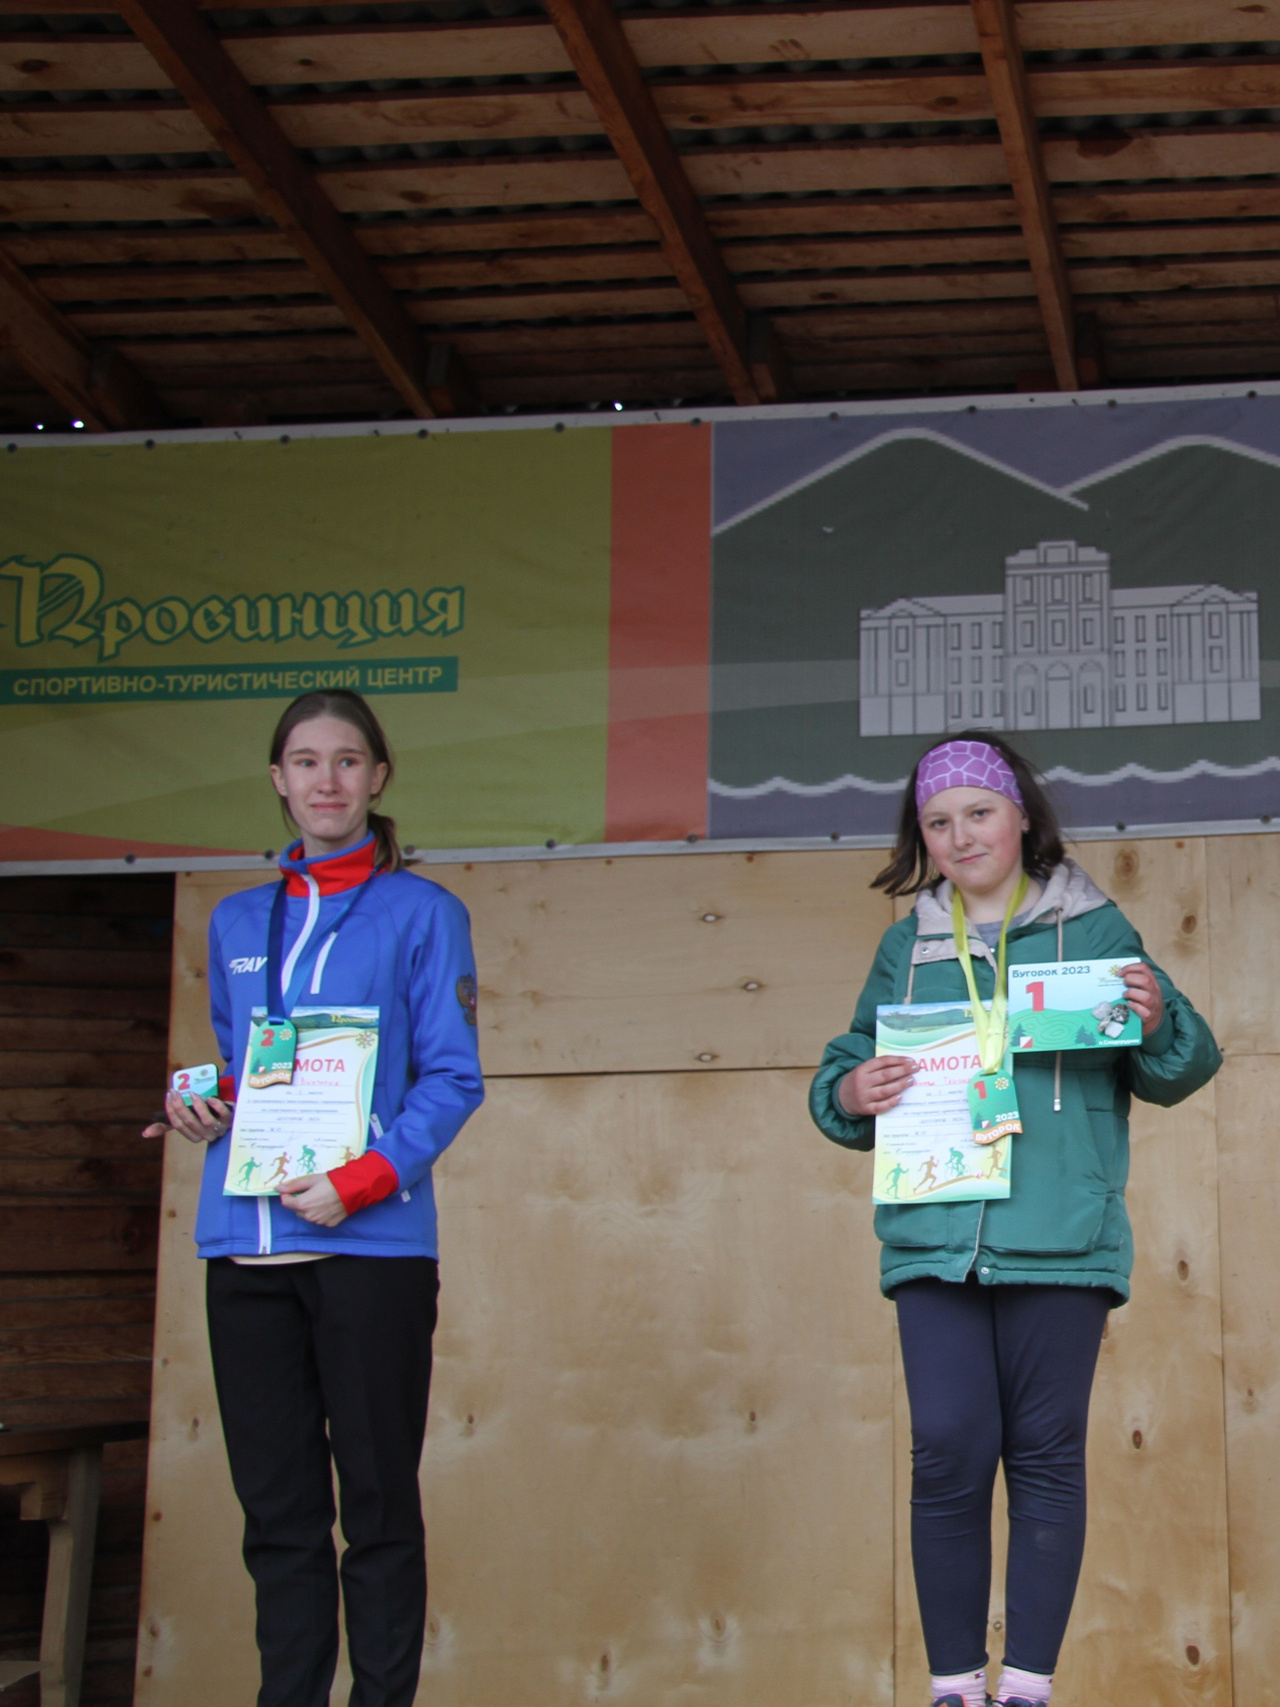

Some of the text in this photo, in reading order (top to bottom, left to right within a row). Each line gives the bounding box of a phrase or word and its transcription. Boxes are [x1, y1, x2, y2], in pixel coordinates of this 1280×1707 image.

[0, 553, 465, 663] Провинция
[13, 665, 443, 696] СПОРТИВНО-ТУРИСТИЧЕСКИЙ ЦЕНТР
[228, 956, 268, 976] RAY
[1061, 965, 1091, 975] 2023
[1025, 981, 1045, 1012] 1
[260, 1029, 275, 1047] 2
[271, 1062, 292, 1070] 2023
[295, 1058, 346, 1073] МОТА
[918, 1054, 982, 1072] АМОТА
[177, 1073, 191, 1090] 2
[973, 1080, 987, 1099] 1
[995, 1111, 1019, 1122] 2023
[975, 1122, 1021, 1141] БУГОРОК
